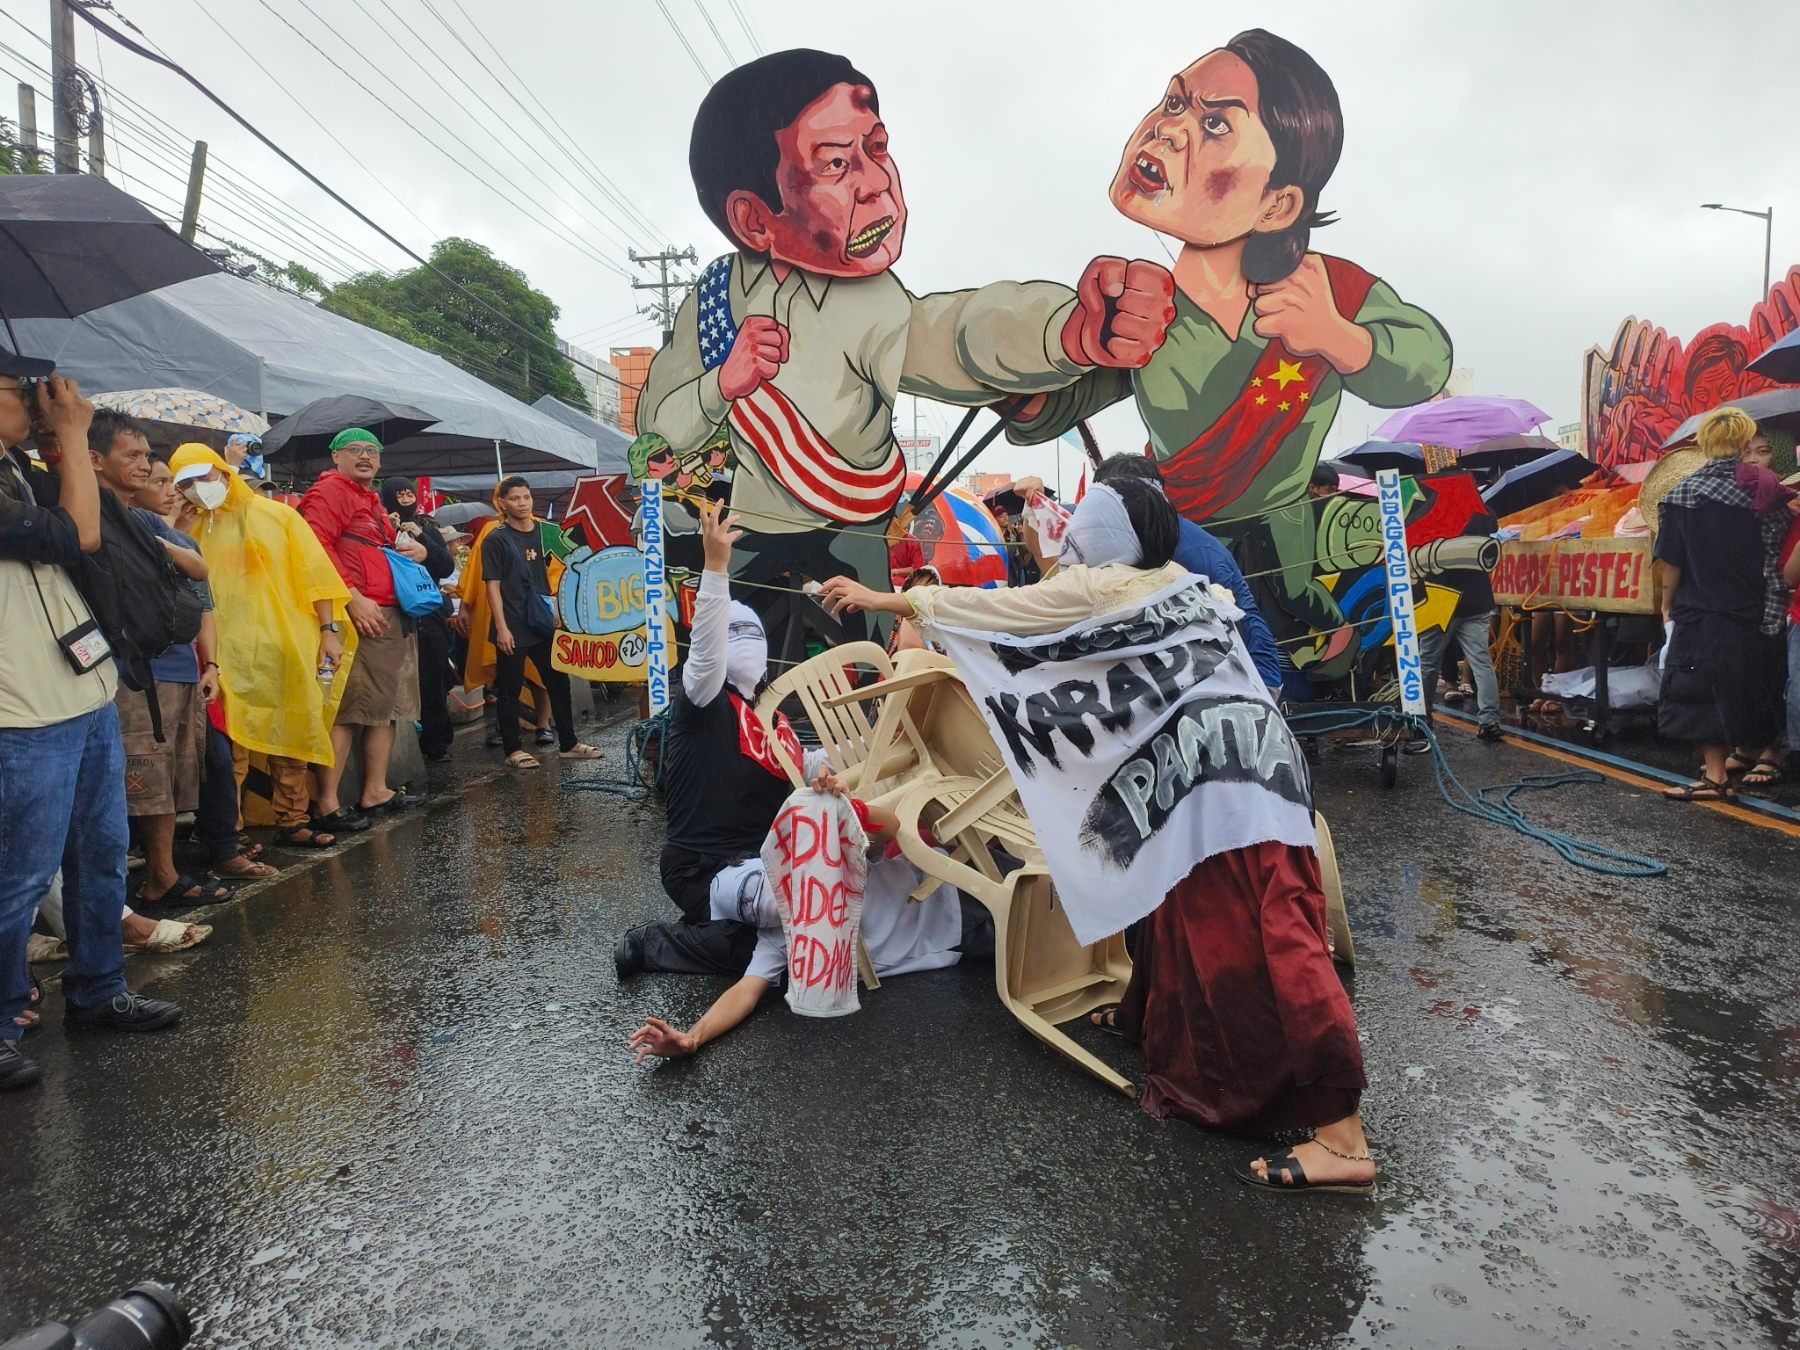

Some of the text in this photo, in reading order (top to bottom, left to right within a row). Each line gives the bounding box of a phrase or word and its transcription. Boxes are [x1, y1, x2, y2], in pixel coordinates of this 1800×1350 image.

[642, 482, 666, 705] UMBAGANG PILIPINAS
[1379, 474, 1421, 701] UMBAGANG PILIPINAS
[1557, 552, 1643, 600] PESTE!
[72, 641, 91, 662] EDIA
[557, 635, 617, 669] SAHOD
